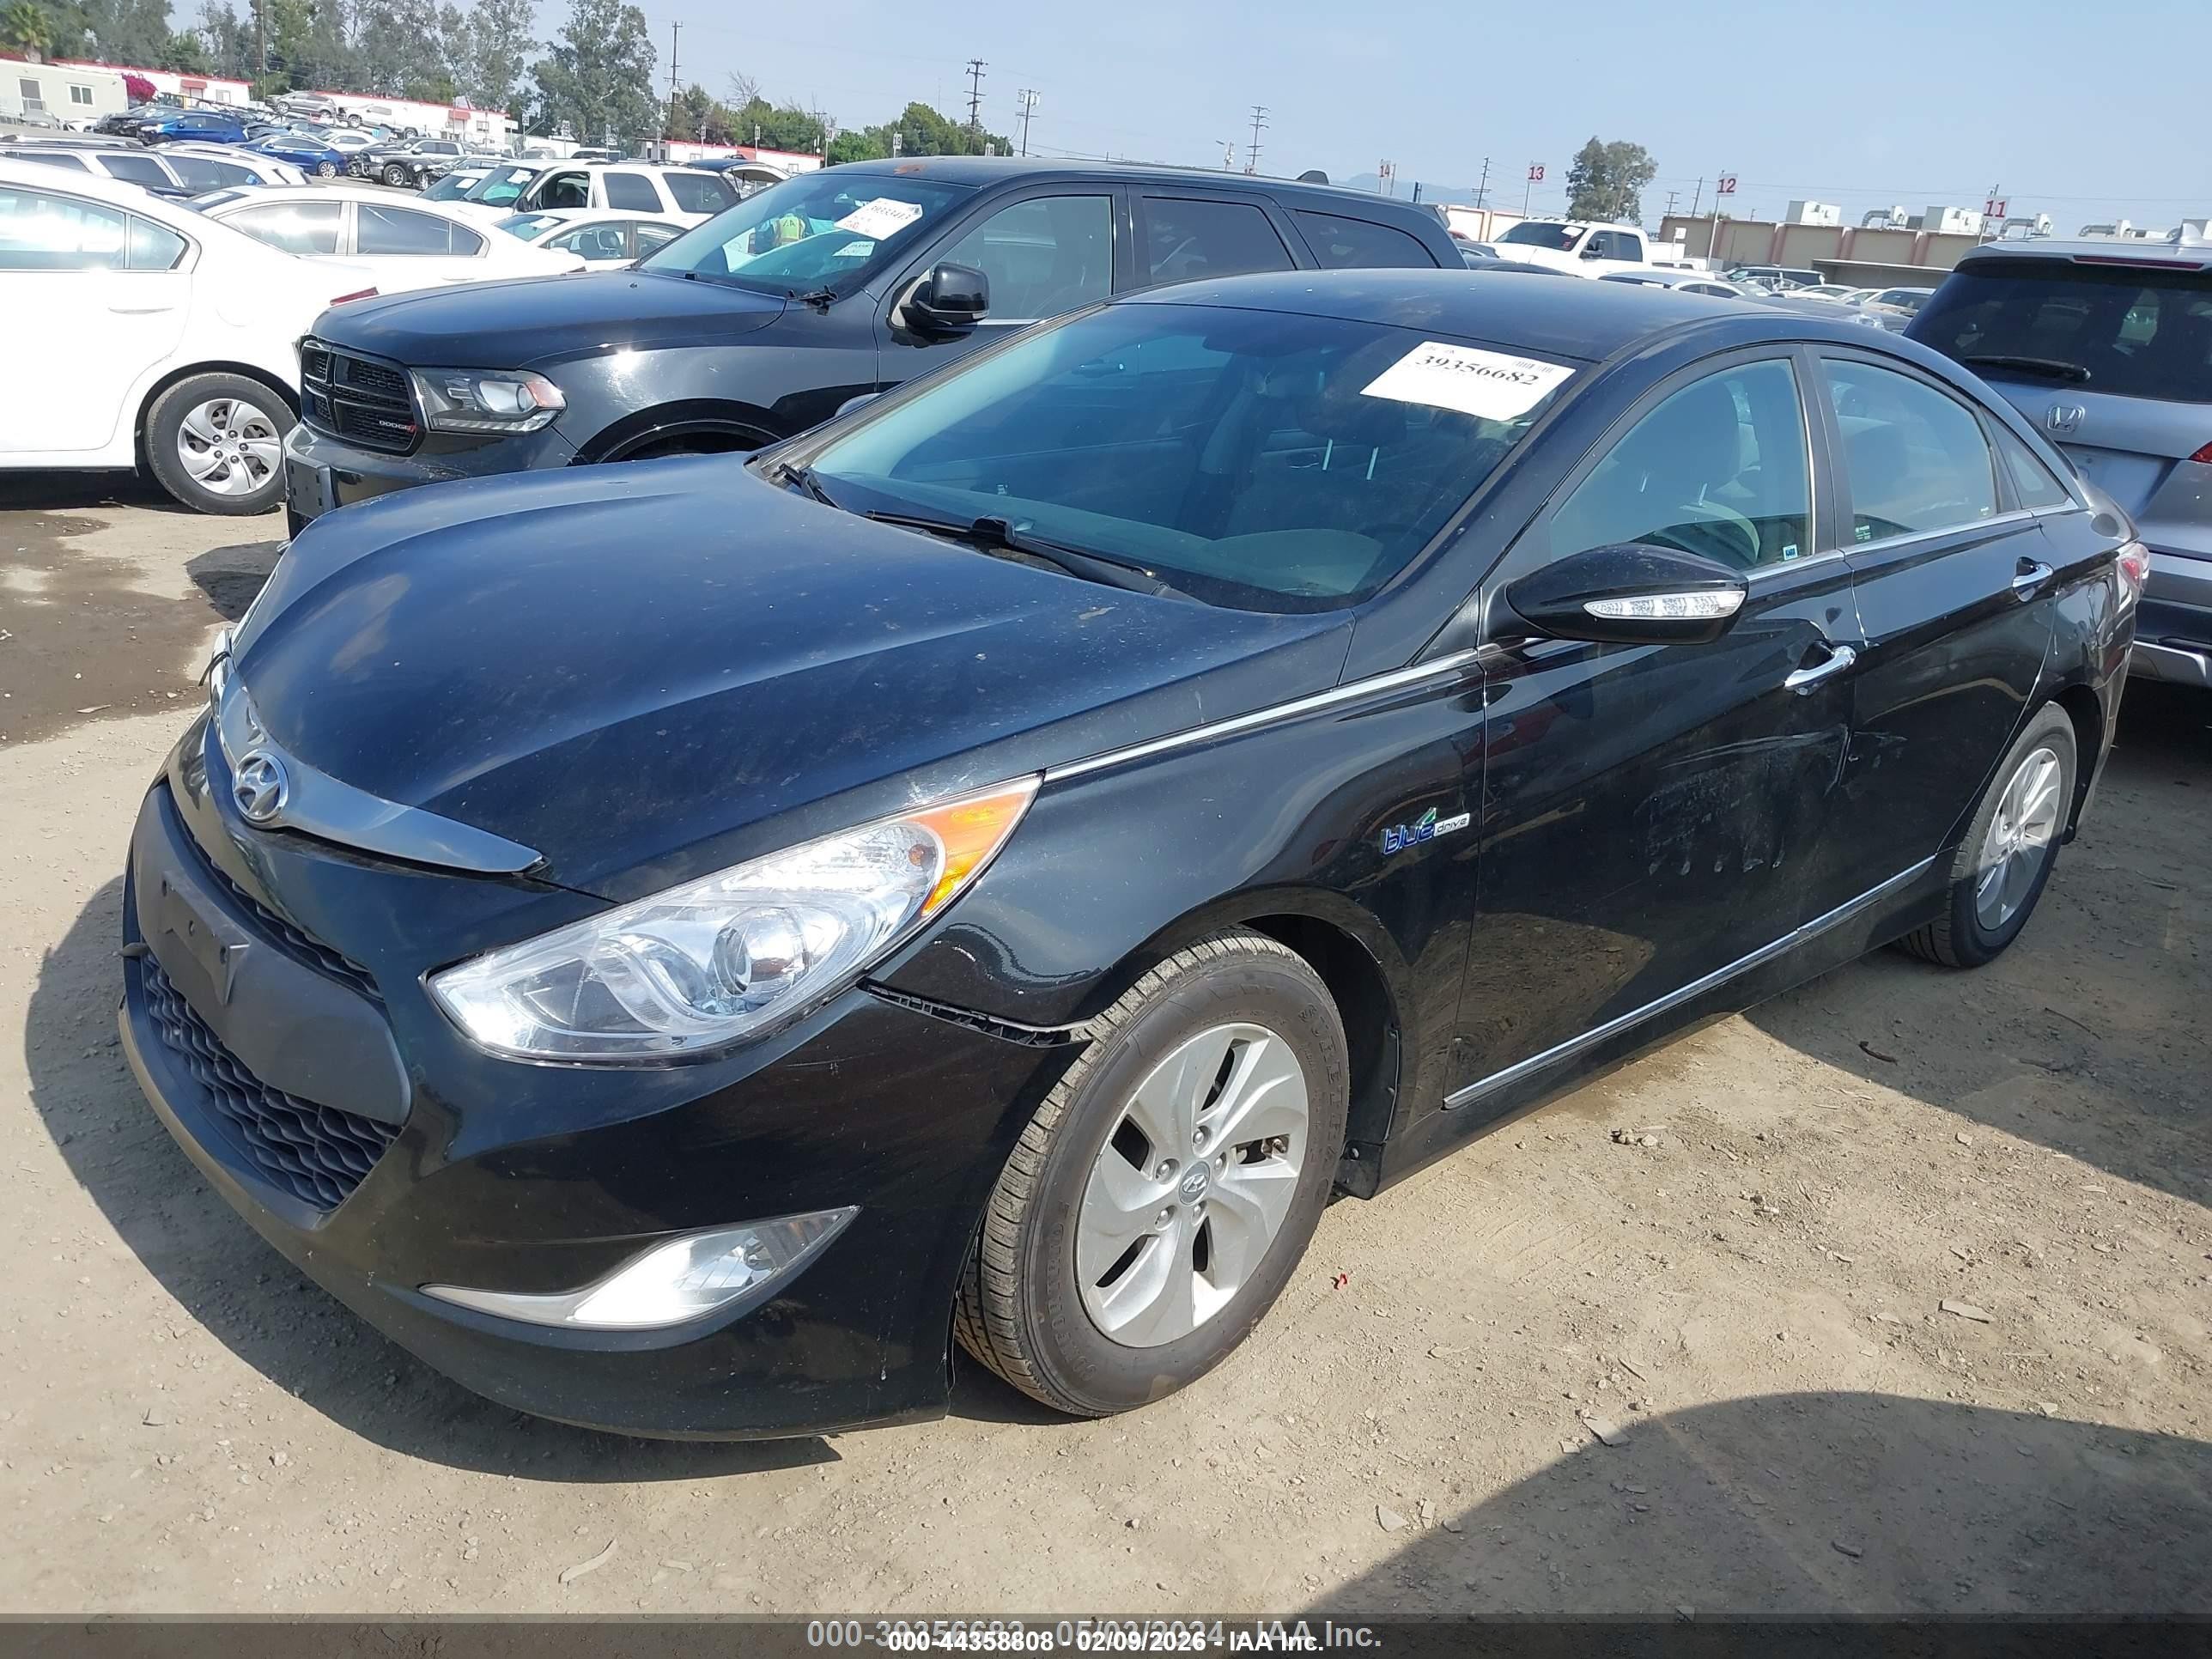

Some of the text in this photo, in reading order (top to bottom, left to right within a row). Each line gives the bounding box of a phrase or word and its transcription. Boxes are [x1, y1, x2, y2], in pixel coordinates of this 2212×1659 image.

[893, 136, 902, 146] 19
[1380, 164, 1390, 177] 14
[1528, 166, 1544, 180] 13
[1717, 178, 1736, 193] 12
[1984, 199, 2006, 218] 11
[1416, 355, 1540, 386] 39356682
[379, 420, 411, 431] DODGE
[1437, 817, 1468, 833] drive
